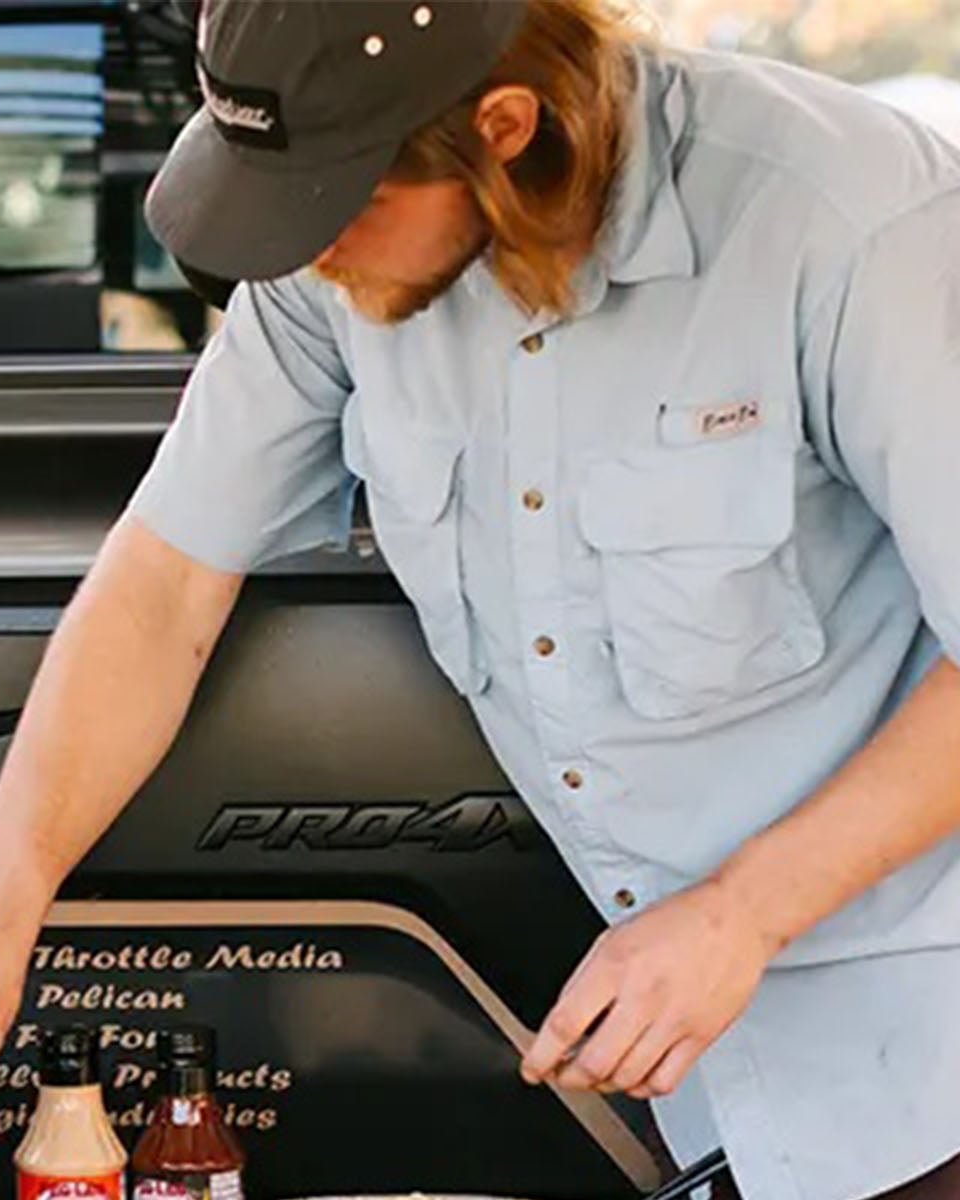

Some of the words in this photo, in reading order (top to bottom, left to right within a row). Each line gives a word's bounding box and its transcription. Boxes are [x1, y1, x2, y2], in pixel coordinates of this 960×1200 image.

[35, 945, 192, 970] Throttle
[205, 943, 343, 969] Media
[36, 984, 186, 1010] Pelican
